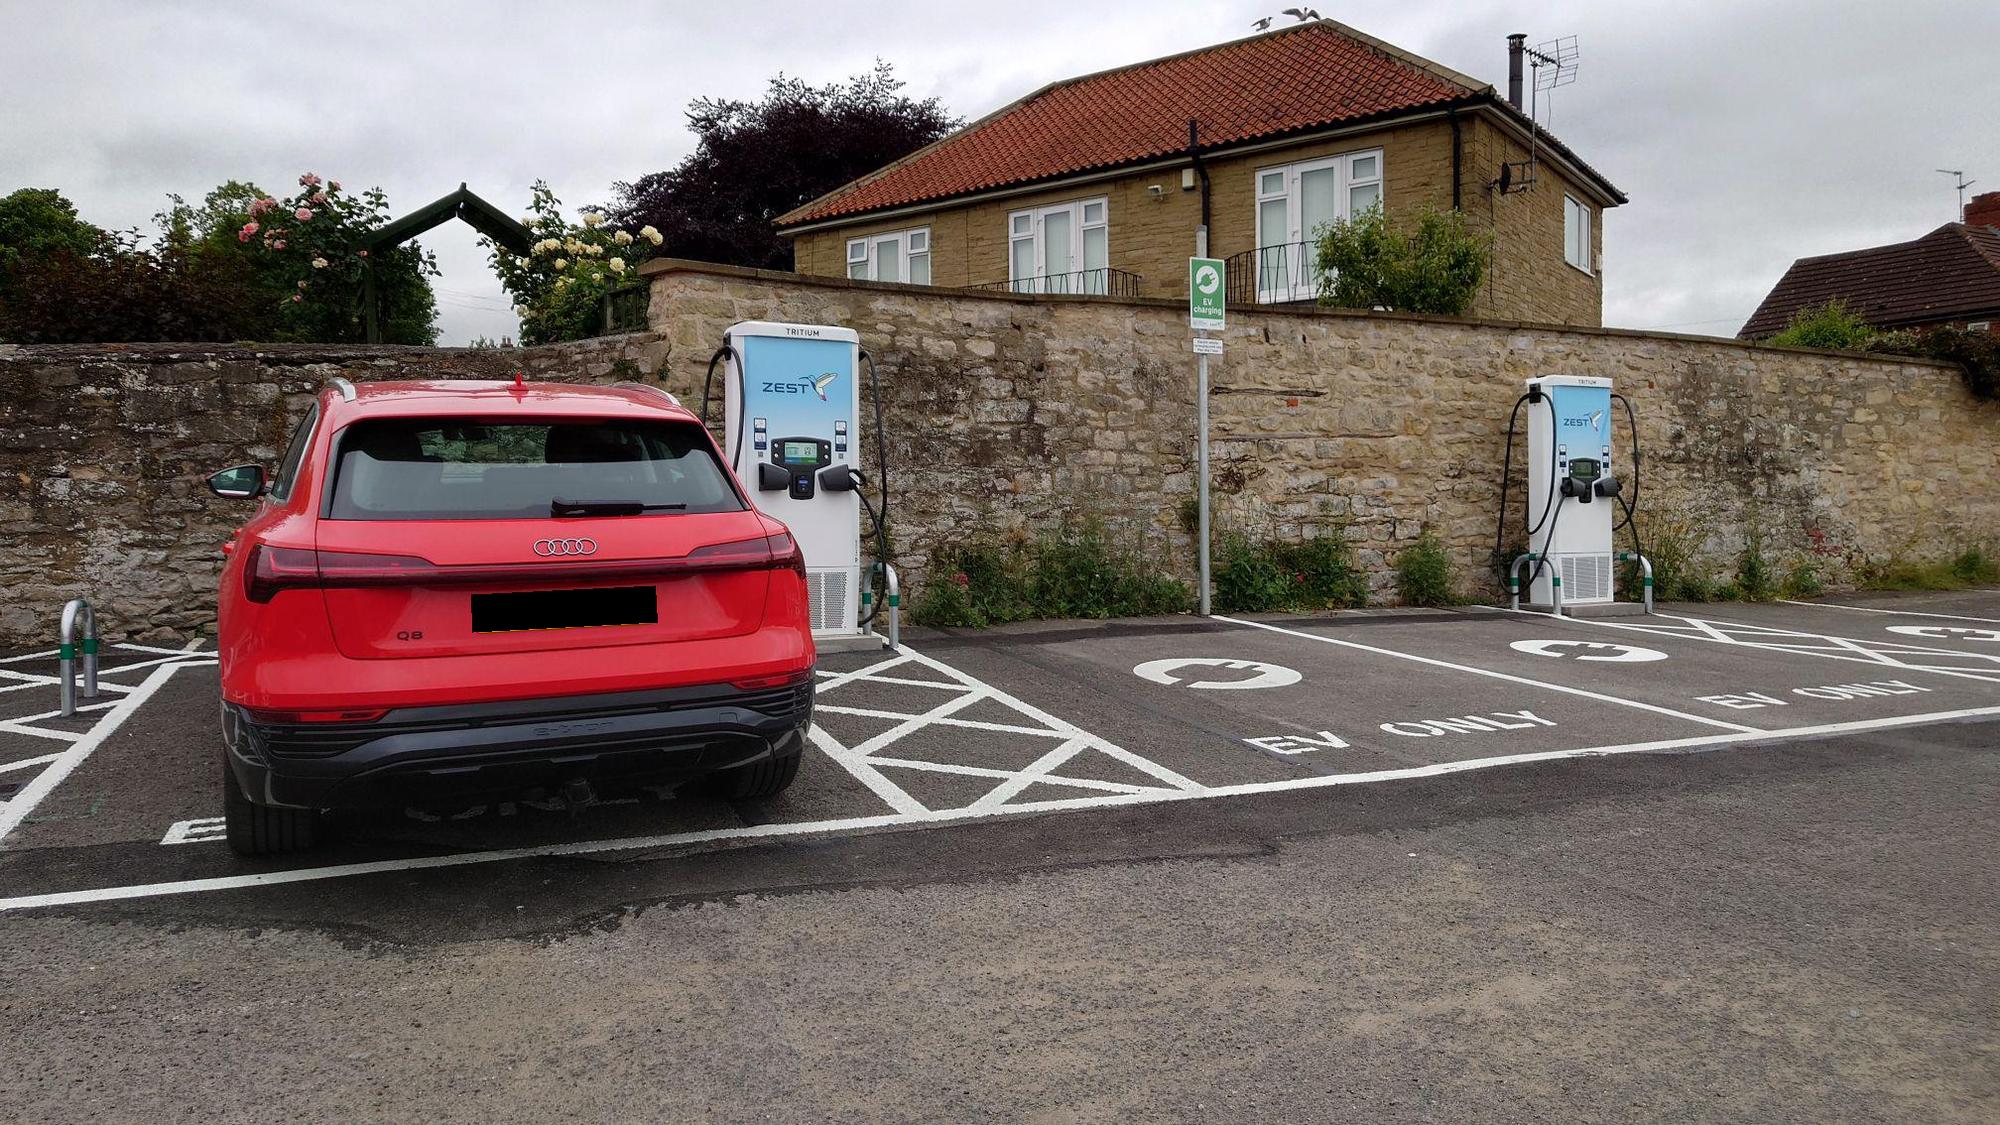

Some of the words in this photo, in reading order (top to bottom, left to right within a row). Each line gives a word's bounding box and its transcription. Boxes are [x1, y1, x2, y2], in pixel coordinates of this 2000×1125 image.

[1193, 305, 1222, 315] charging
[785, 327, 820, 337] TRITIUM
[762, 382, 809, 395] ZEST
[1563, 418, 1589, 427] ZEST
[396, 631, 423, 642] Q8
[1695, 692, 1788, 709] EV
[1792, 680, 1933, 700] ONLY
[1241, 731, 1351, 755] EV
[1379, 710, 1558, 737] ONLY
[159, 816, 227, 845] E
